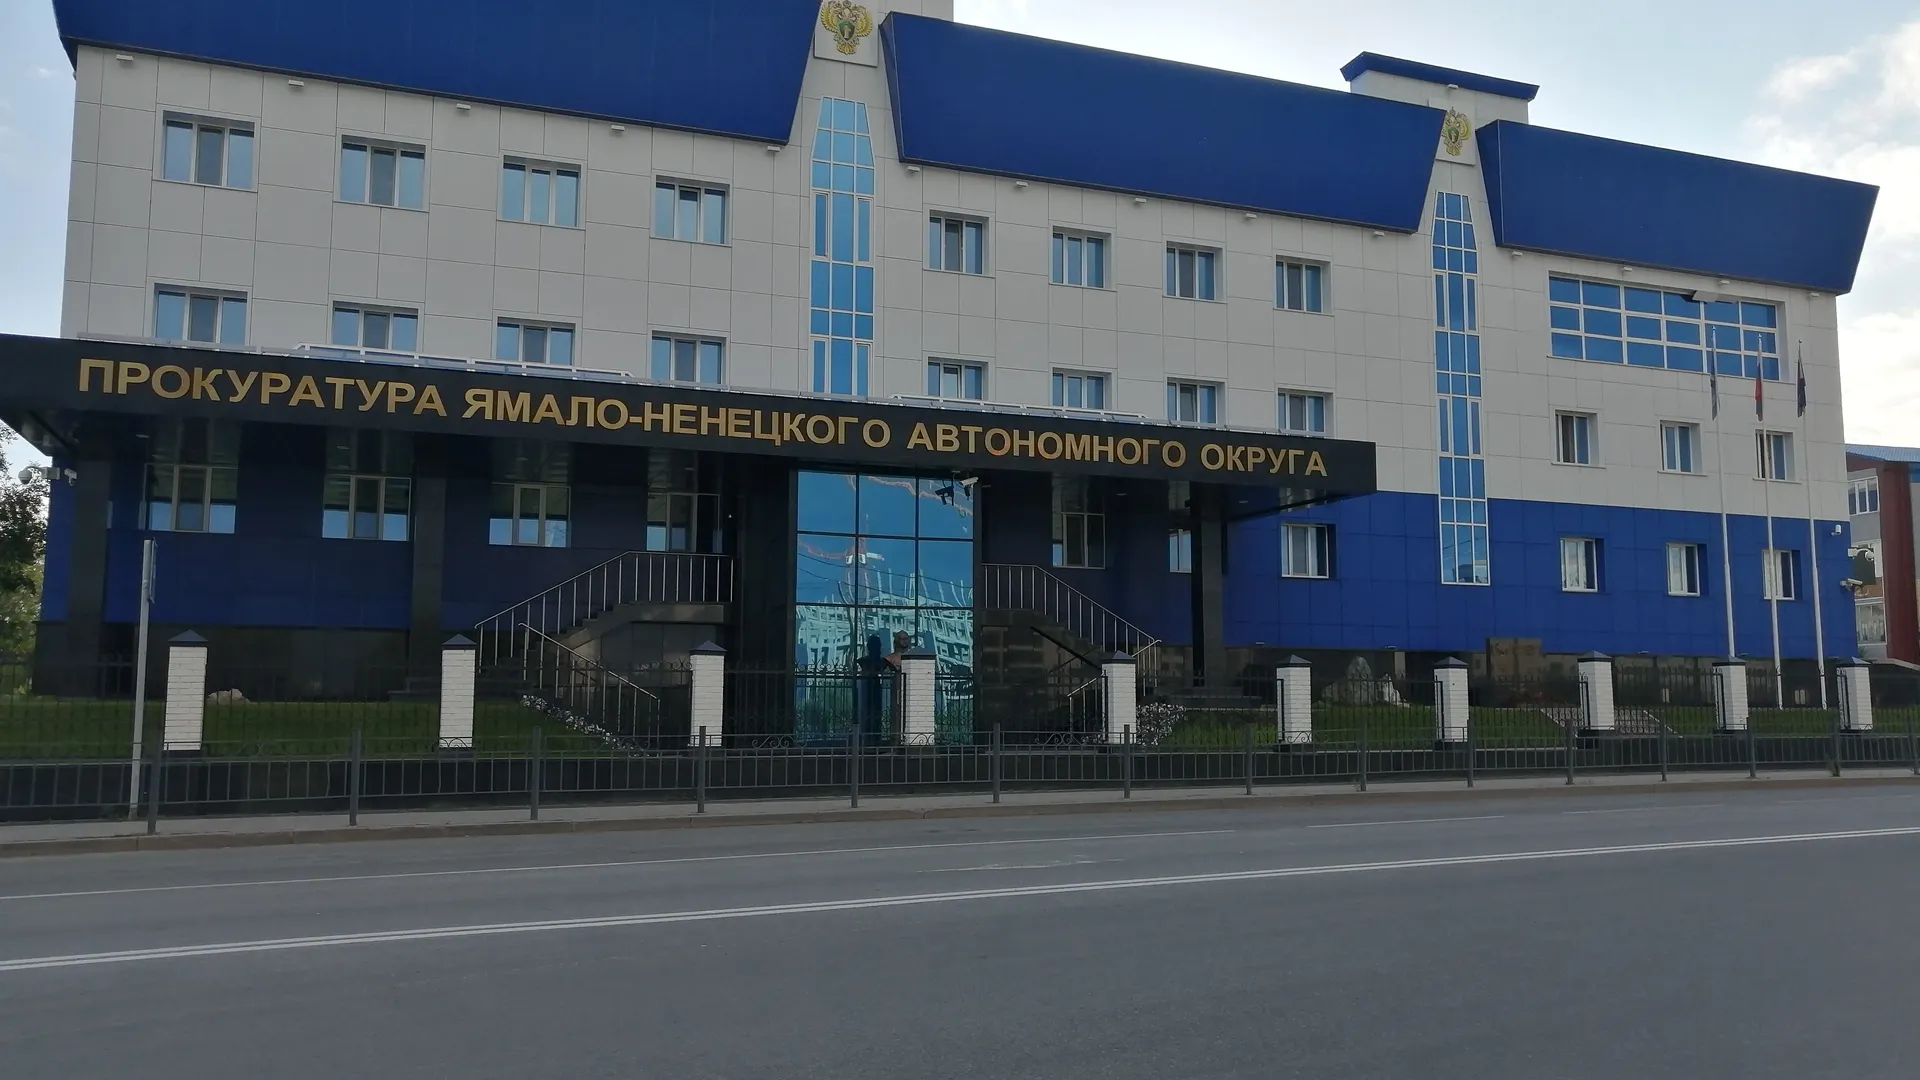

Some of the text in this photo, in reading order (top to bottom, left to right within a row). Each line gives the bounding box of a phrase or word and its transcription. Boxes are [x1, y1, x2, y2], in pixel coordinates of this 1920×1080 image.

[79, 358, 1328, 478] ПРОКУРАТУРА ЯМАЛО-НЕНЕЦКОГО АВТОНОМНОГО ОКРУГА
